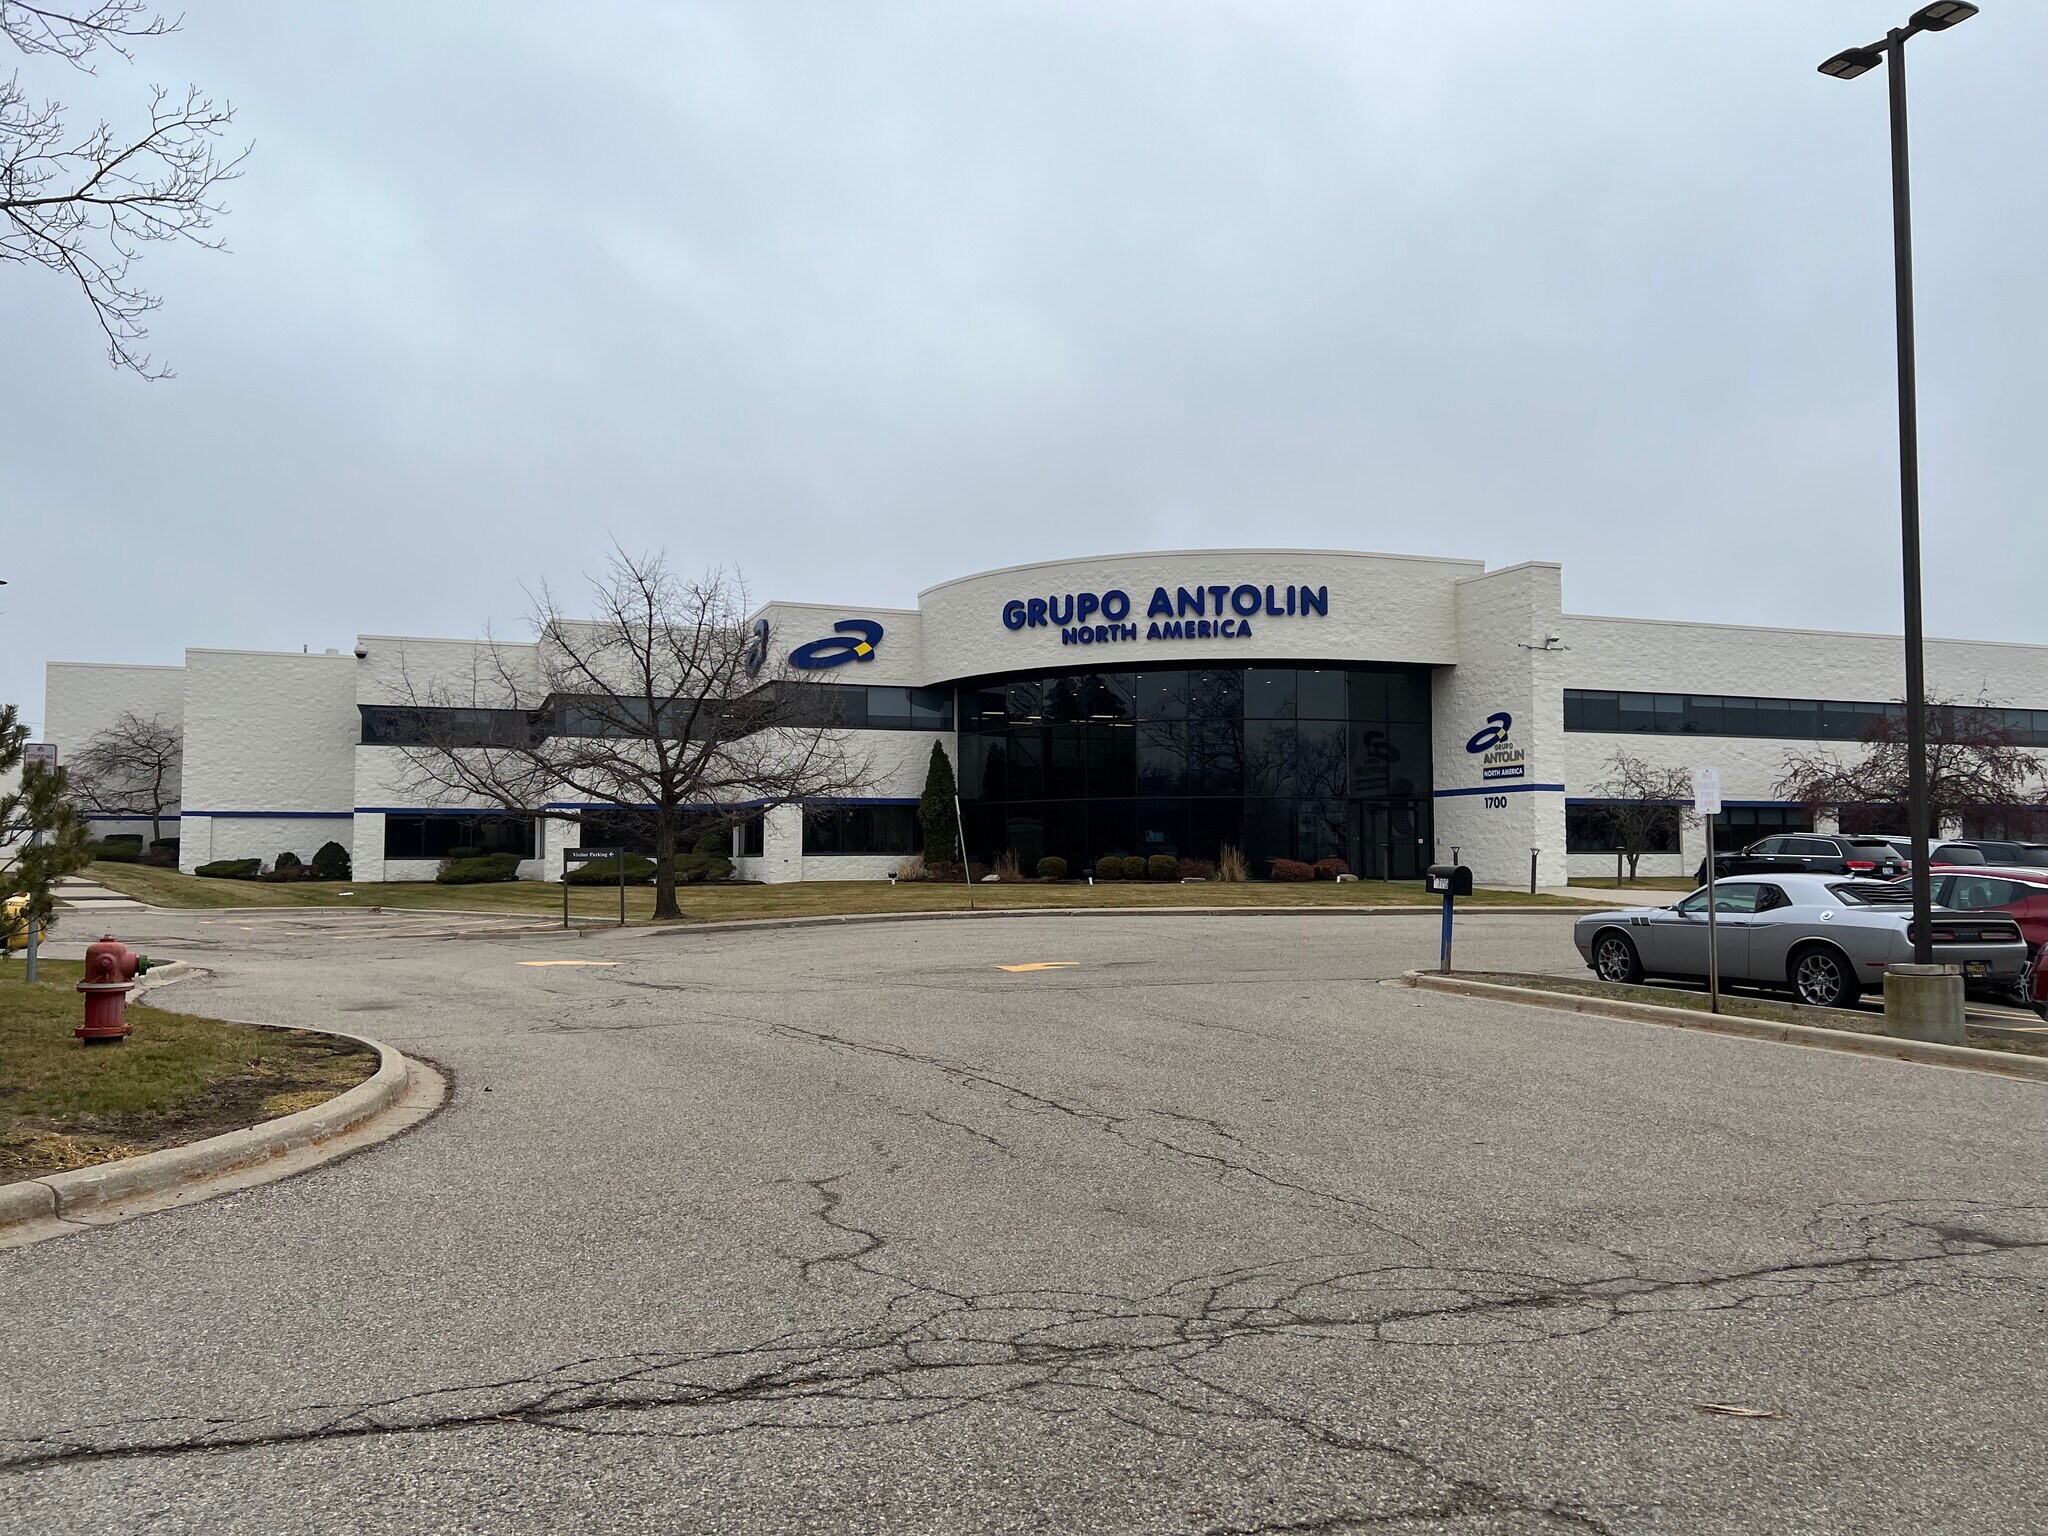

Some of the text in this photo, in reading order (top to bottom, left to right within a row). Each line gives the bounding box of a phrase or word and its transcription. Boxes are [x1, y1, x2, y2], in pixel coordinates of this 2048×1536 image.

[1002, 584, 1329, 630] GRUPO ANTOLIN
[1061, 618, 1253, 645] NORTH AMERICA
[1494, 742, 1513, 751] GRUPO
[1483, 749, 1525, 764] ANTOLIN
[1483, 767, 1523, 777] NORTH AMERICA
[1484, 795, 1507, 809] 1700
